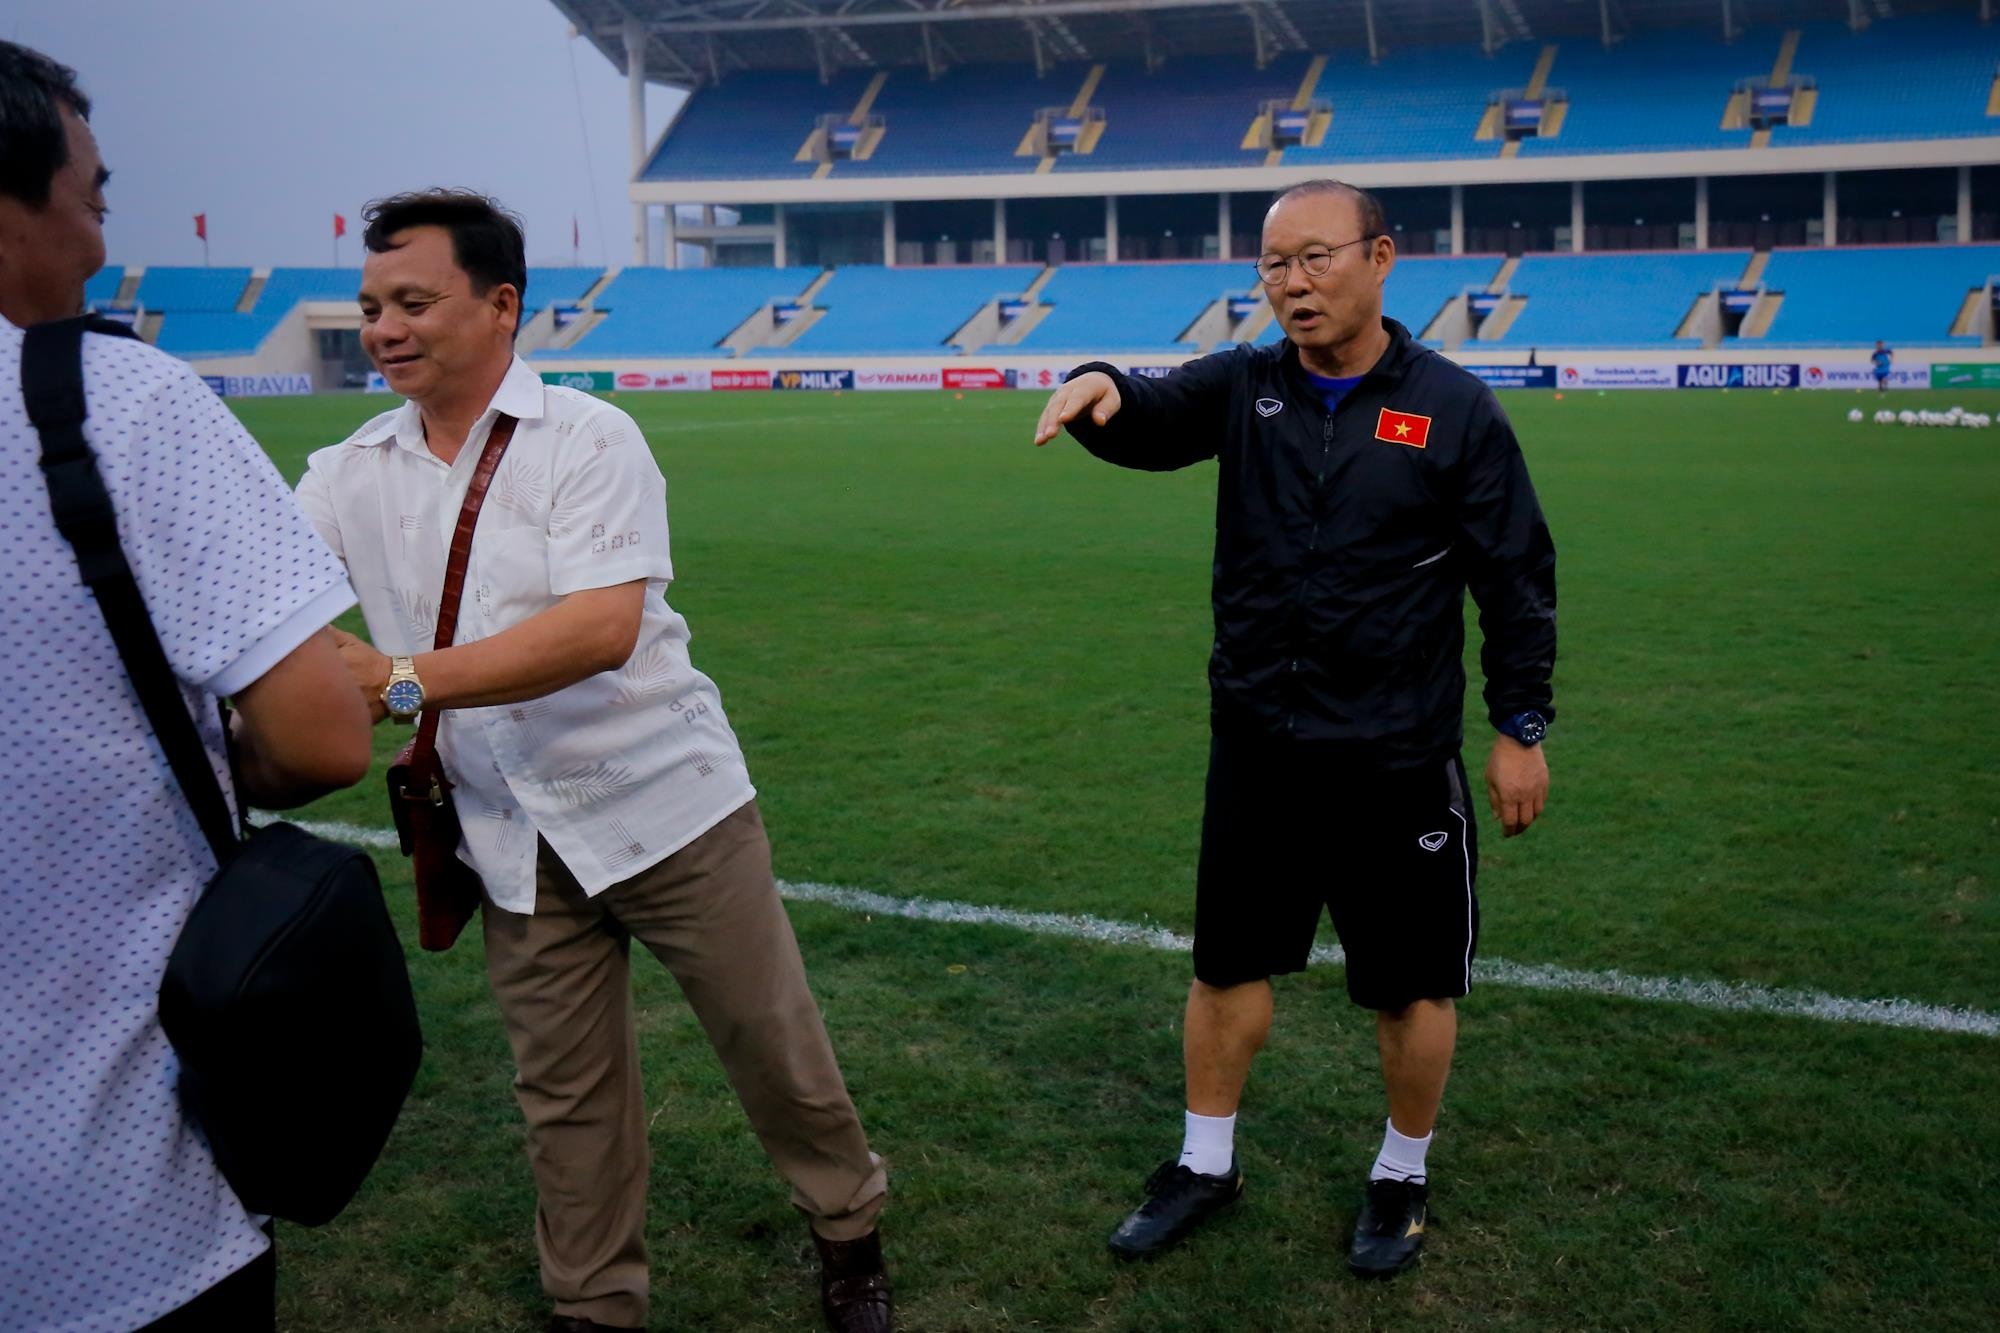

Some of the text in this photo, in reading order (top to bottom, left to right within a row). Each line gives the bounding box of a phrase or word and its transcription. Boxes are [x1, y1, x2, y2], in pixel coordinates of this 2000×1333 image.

[225, 376, 310, 395] BRAVIA
[878, 374, 939, 384] YANMAR
[1684, 365, 1792, 387] AQUARIUS
